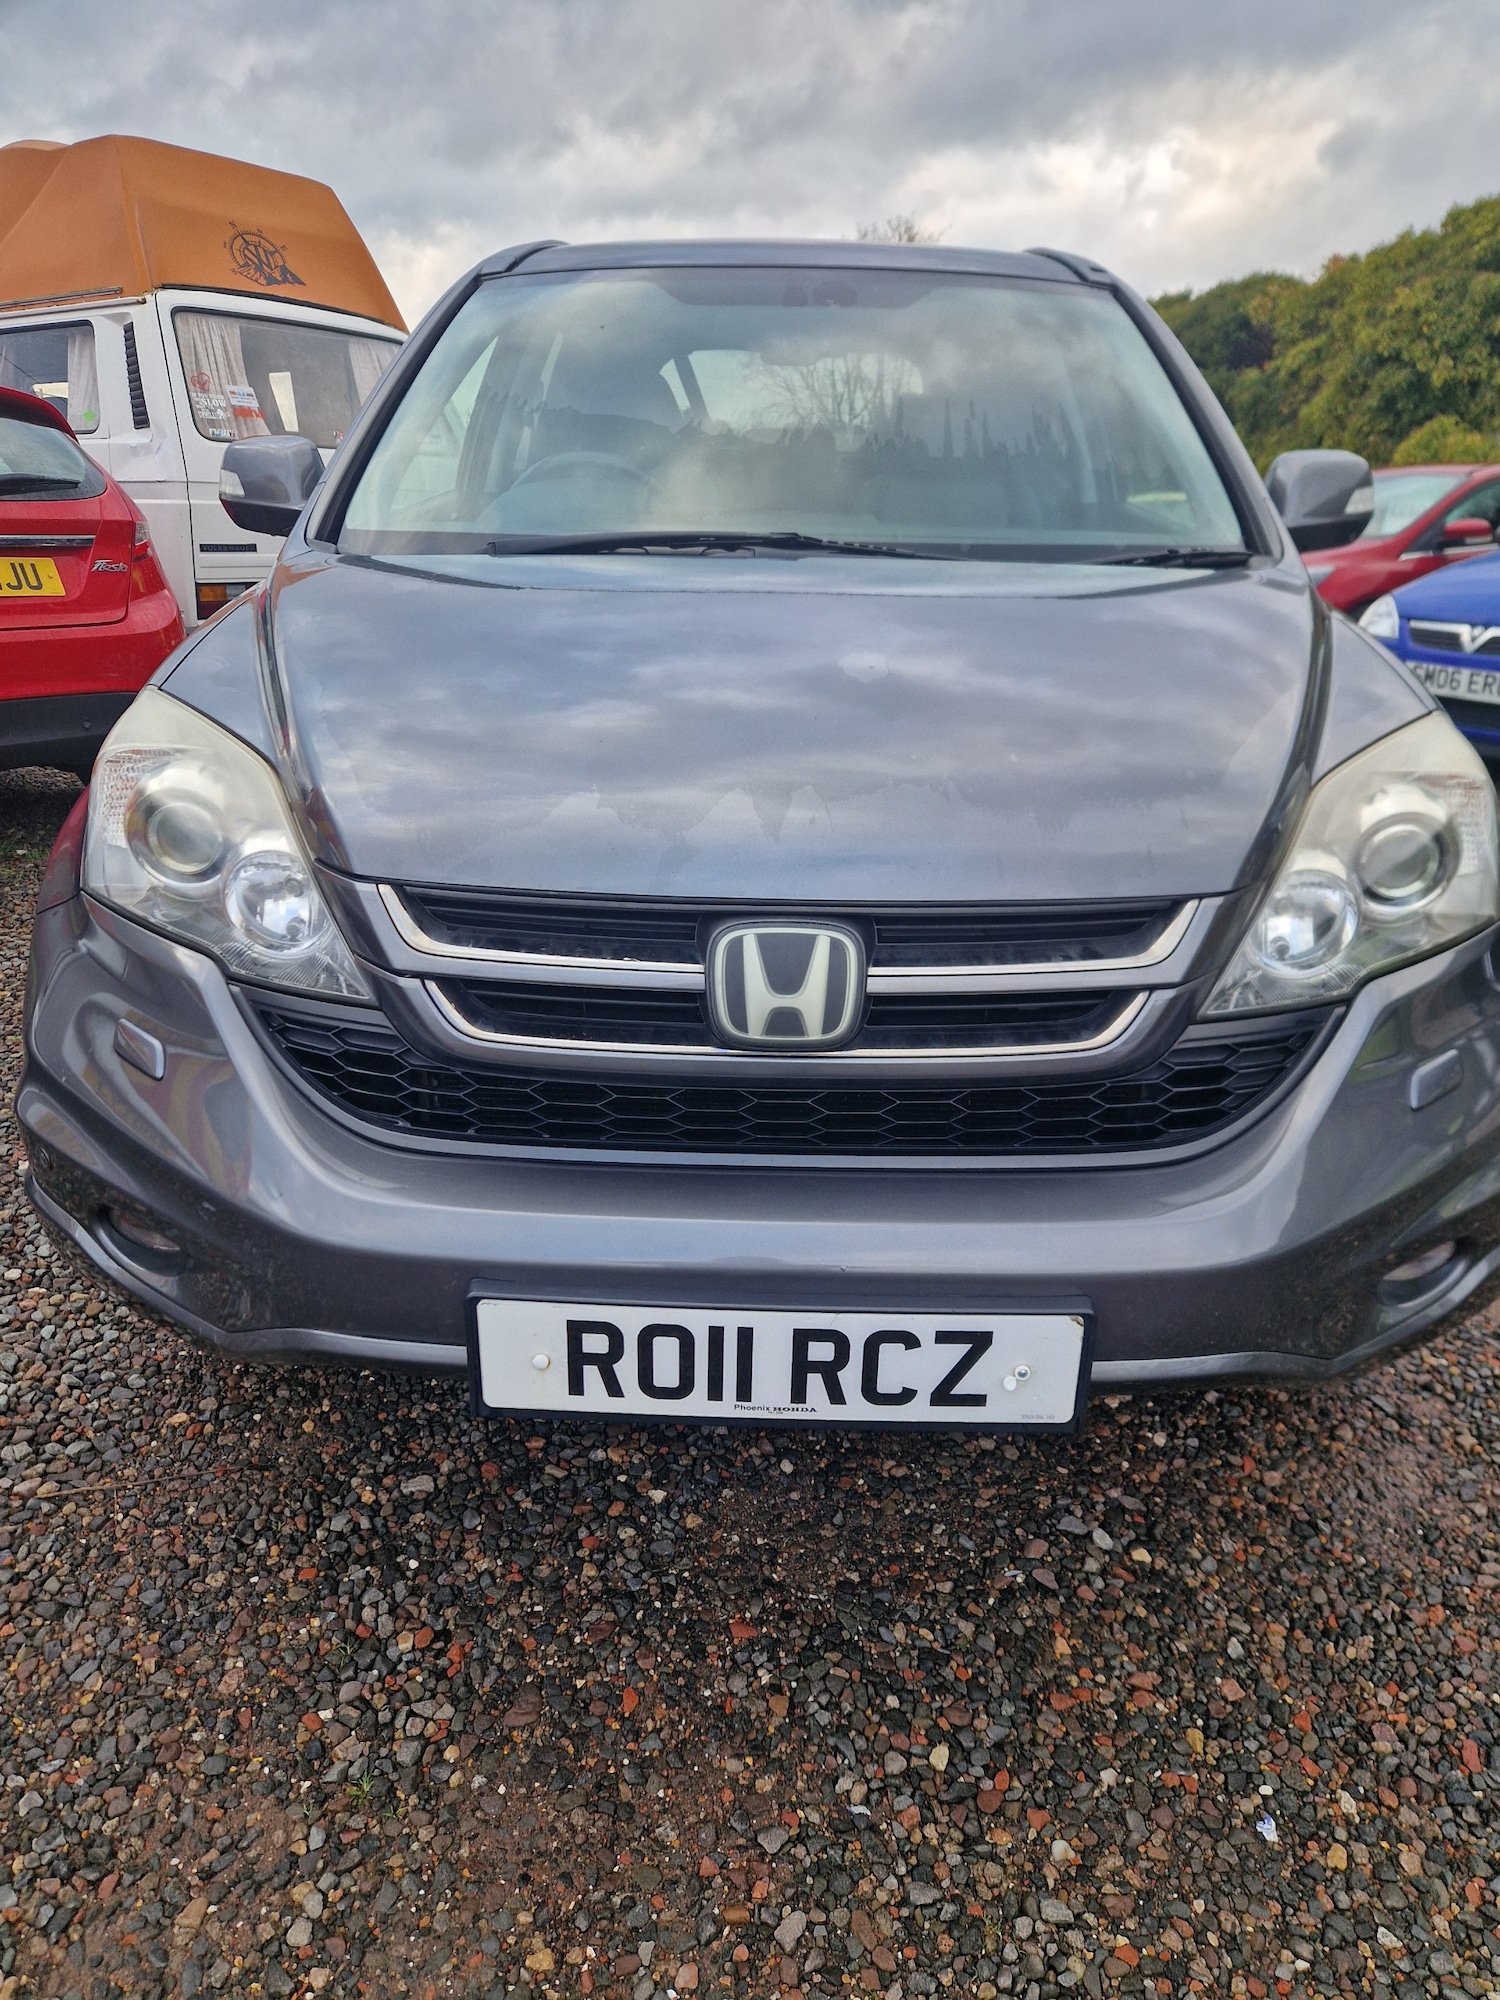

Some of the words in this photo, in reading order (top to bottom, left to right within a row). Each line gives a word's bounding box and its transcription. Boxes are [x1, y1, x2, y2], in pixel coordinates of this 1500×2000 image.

[201, 399, 226, 407] SLOW
[91, 559, 128, 572] Fiesta
[0, 562, 43, 590] JU
[1468, 672, 1500, 697] ER
[567, 1319, 754, 1402] RO11
[790, 1328, 993, 1407] RCZ
[734, 1404, 770, 1412] Phoenix
